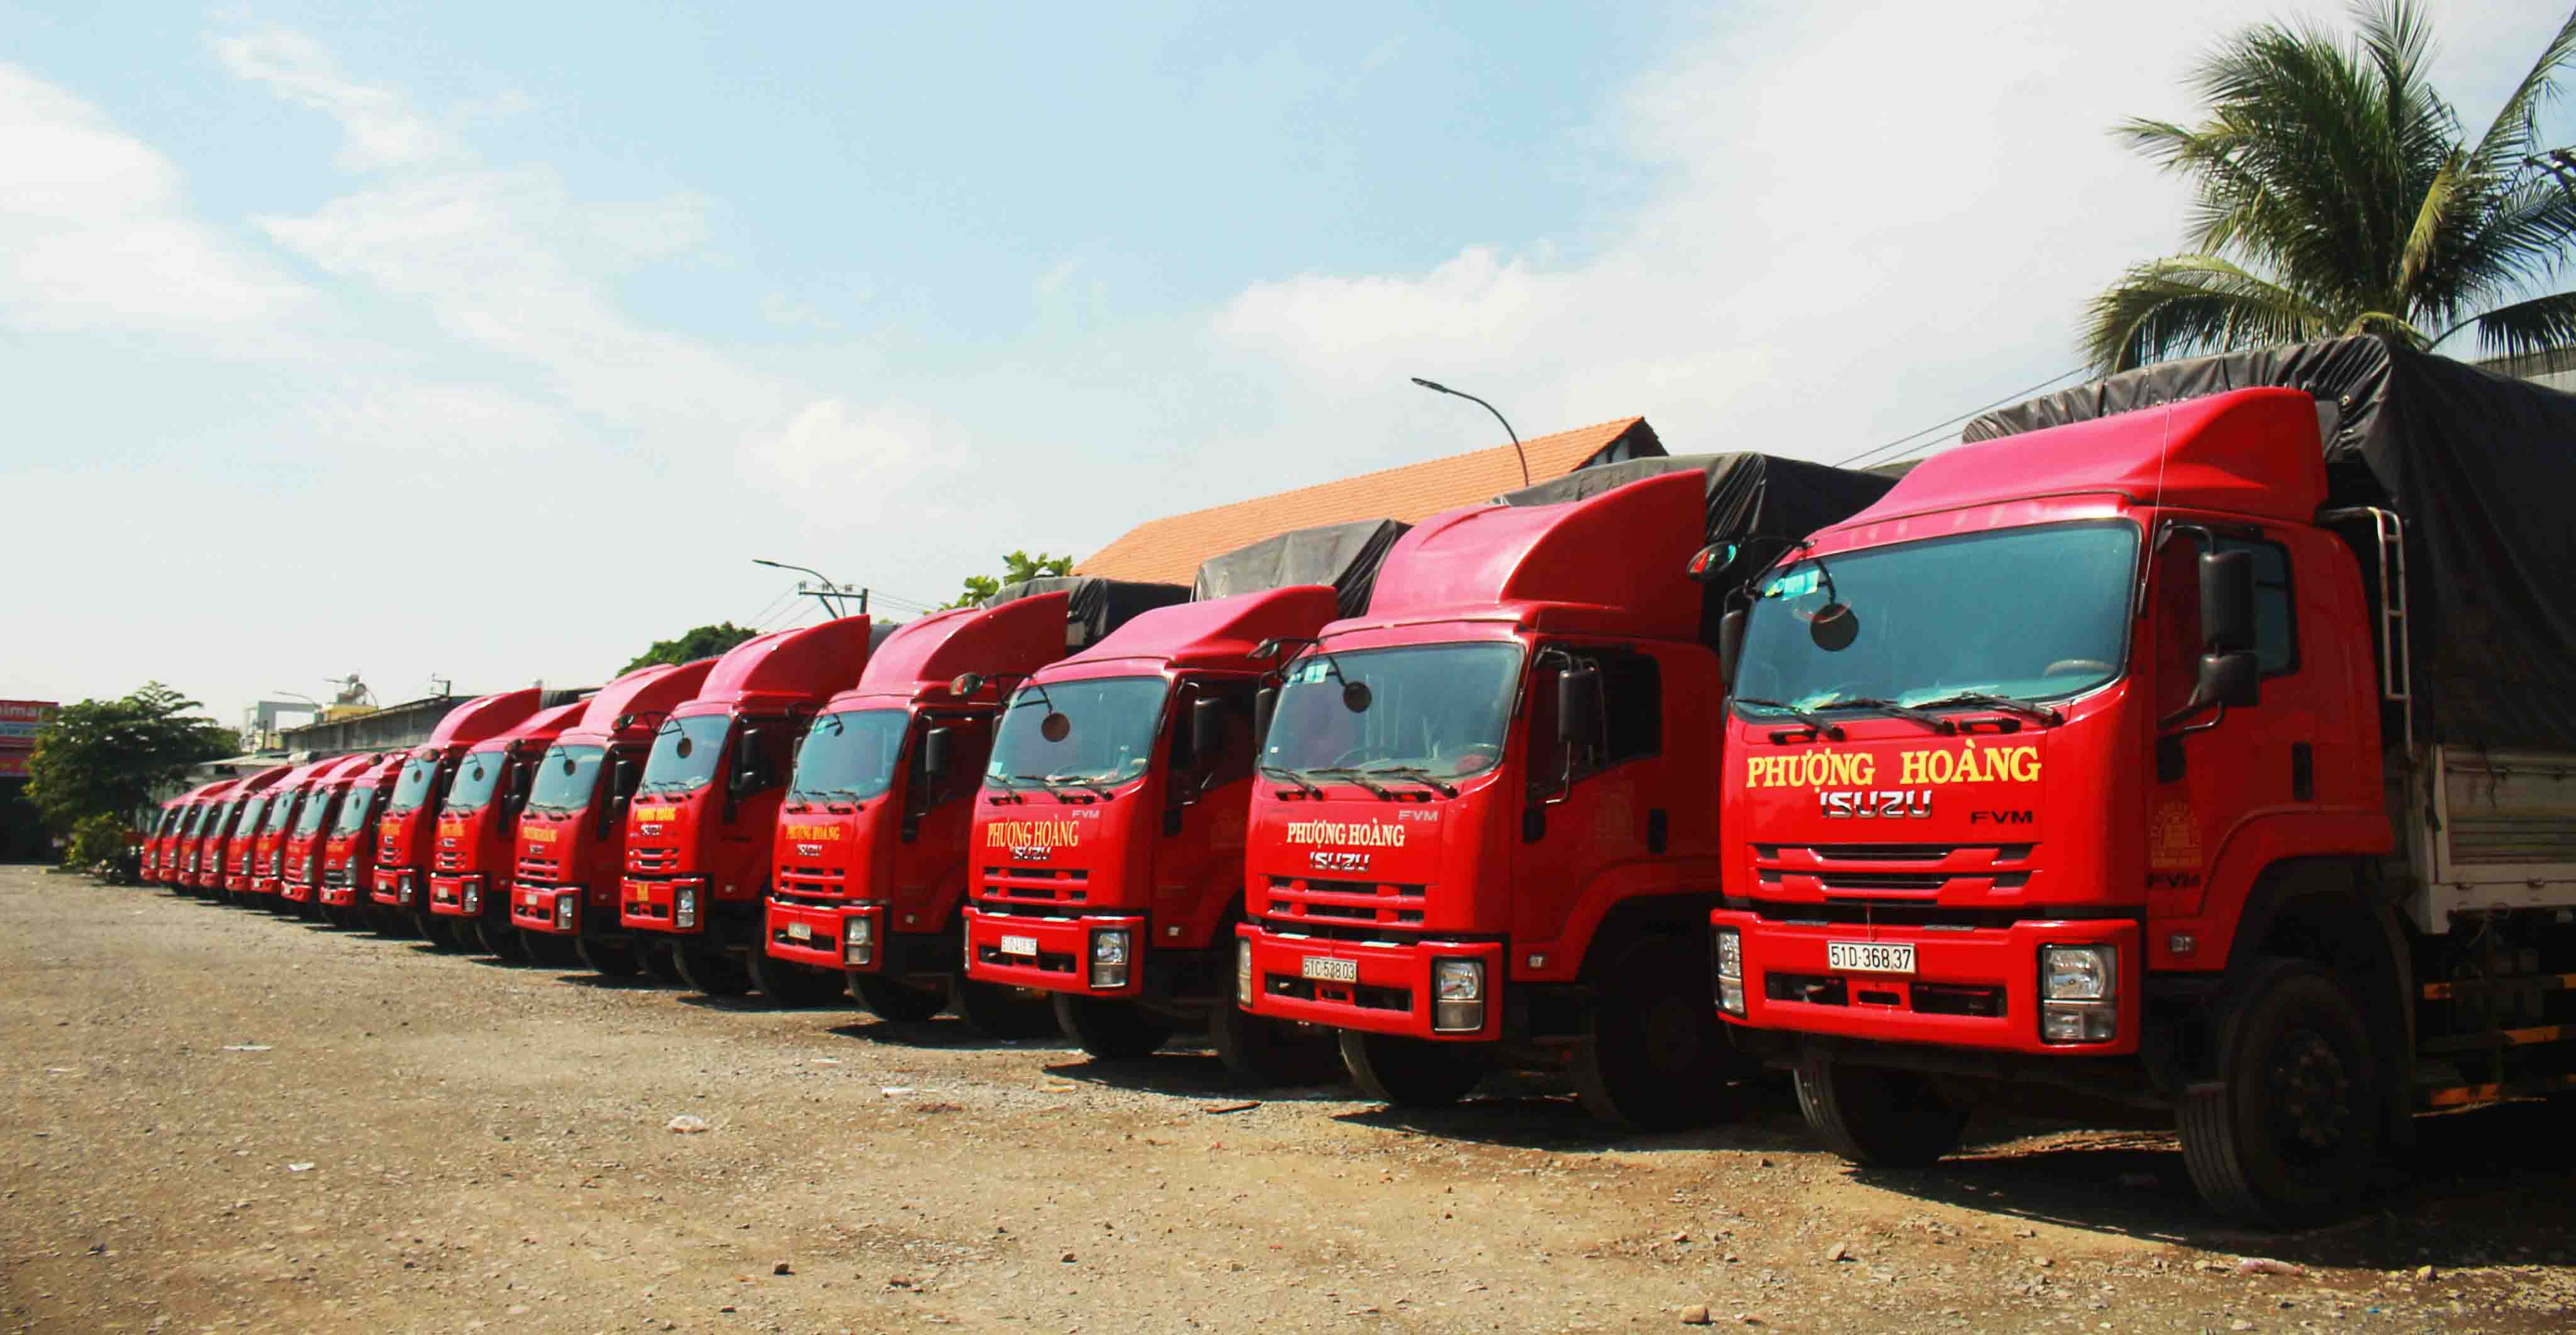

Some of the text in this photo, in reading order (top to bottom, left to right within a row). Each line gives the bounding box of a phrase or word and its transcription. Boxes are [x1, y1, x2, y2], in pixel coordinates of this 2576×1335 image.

[1746, 738, 2043, 793] PHƯỢNG HOÀNG
[1398, 810, 1438, 821] FVM
[1820, 790, 1932, 819] ISUZU
[1970, 810, 2034, 825] FVM
[1286, 817, 1405, 849] PHƯỢNG HOÀNG
[1309, 851, 1370, 871] ISUZU
